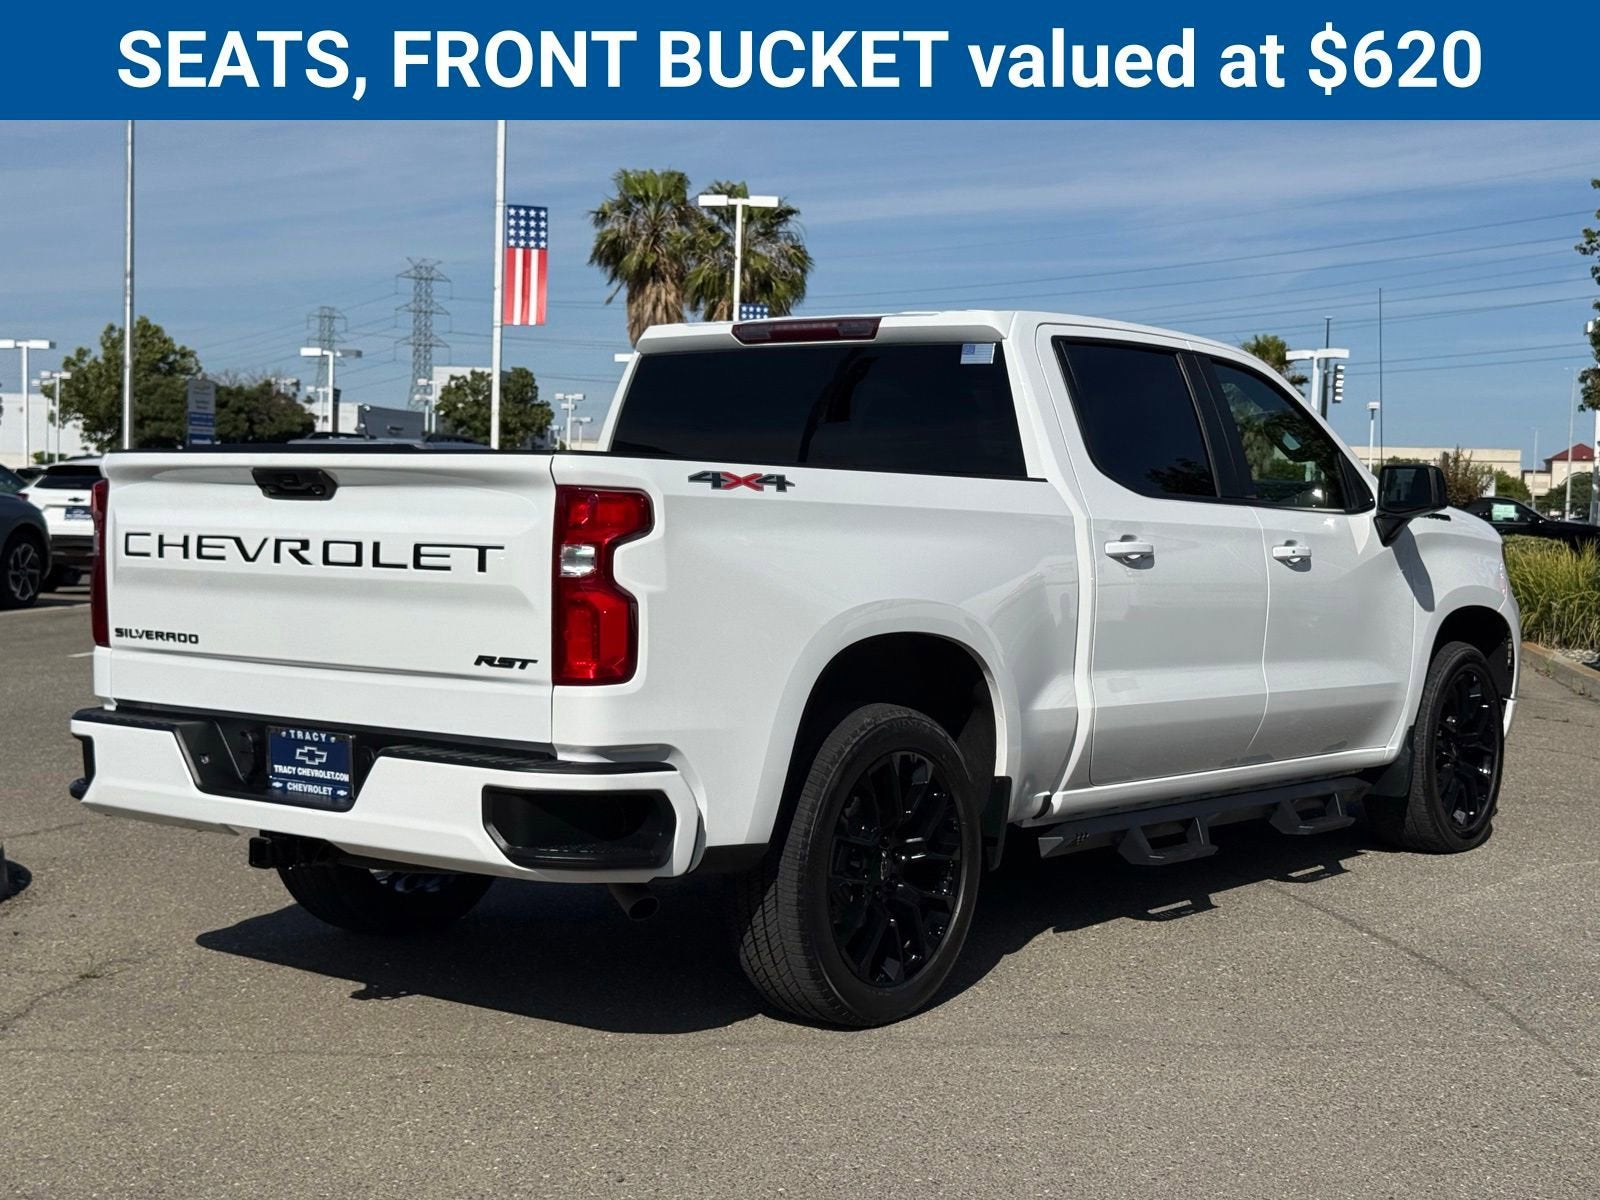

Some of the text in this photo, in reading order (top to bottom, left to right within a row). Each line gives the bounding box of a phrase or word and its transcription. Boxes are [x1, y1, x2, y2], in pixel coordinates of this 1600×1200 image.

[687, 470, 796, 493] 4X4
[124, 531, 505, 573] CHEVROLET
[114, 627, 199, 645] SILVERADO
[474, 655, 539, 671] RST
[289, 729, 327, 743] TRACY
[286, 782, 333, 796] CHEVROLET
